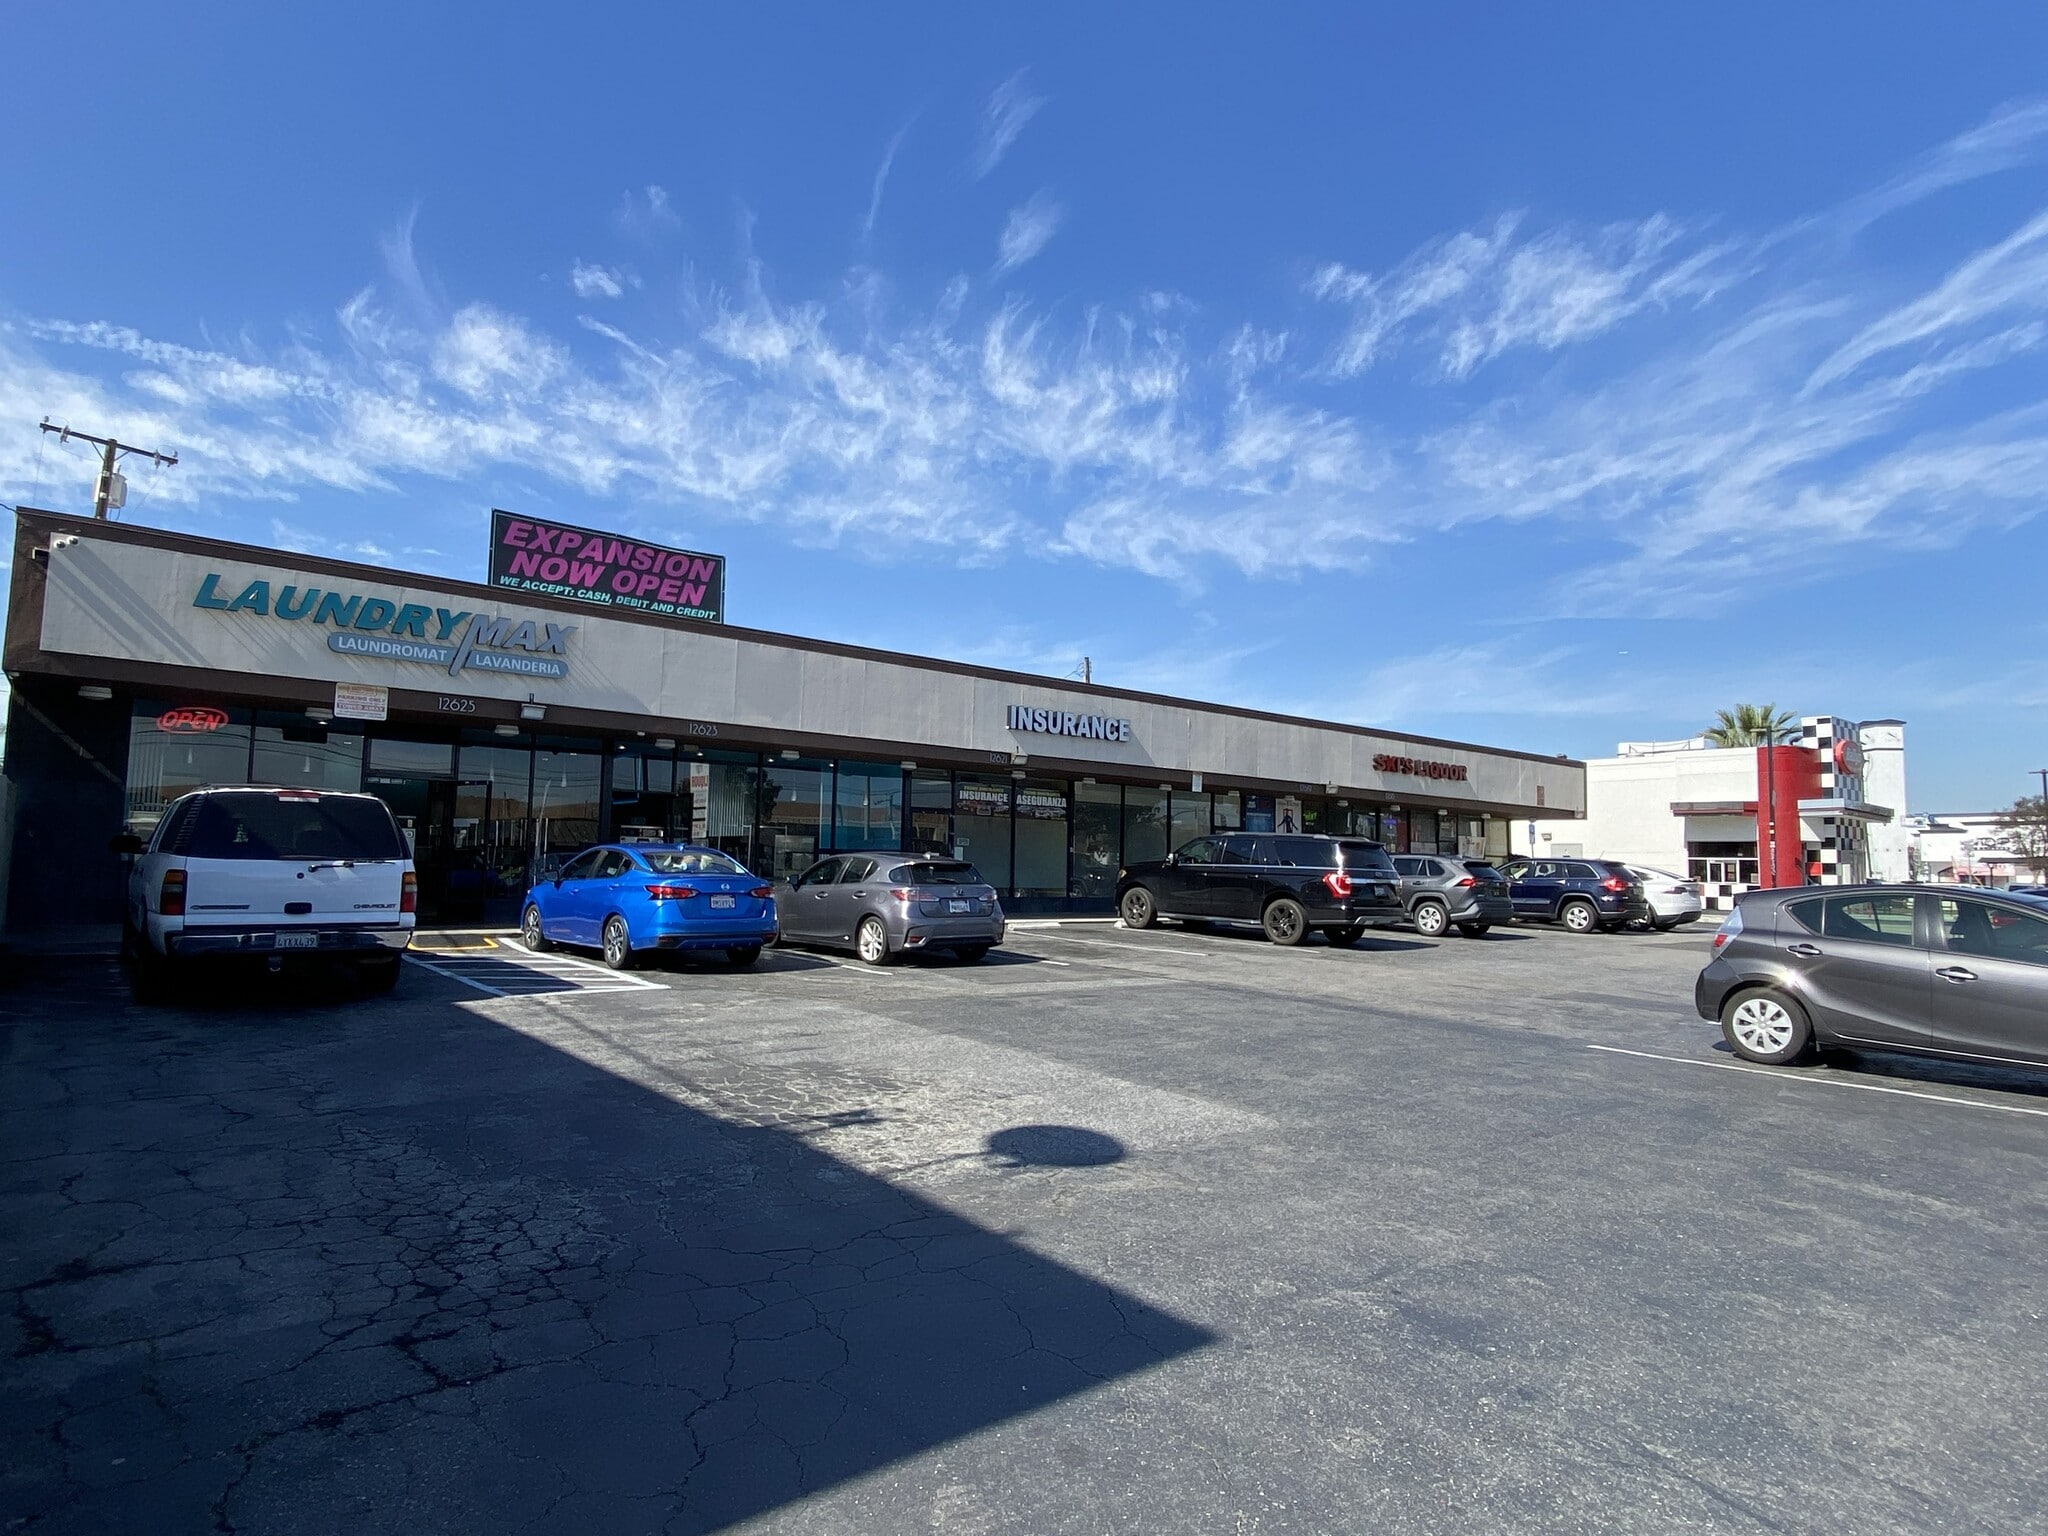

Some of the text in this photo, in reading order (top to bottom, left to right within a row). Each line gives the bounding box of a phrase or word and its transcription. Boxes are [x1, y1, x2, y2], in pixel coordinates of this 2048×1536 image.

[503, 520, 716, 582] EXPANSION
[509, 551, 706, 606] NOW OPEN
[500, 575, 717, 620] WE ACCEPT: CASH, DEBIT AND CREDIT
[338, 635, 448, 662] LAUNDROMAT
[475, 653, 560, 675] LAVANDERIA
[438, 697, 476, 713] 12625
[162, 711, 221, 731] OPEN
[689, 723, 718, 737] 12623
[1008, 705, 1130, 742] INSURANCE
[1414, 760, 1467, 781] LIQUOR
[960, 790, 1009, 802] INSURANCE
[1016, 794, 1067, 807] ASEGURANZA
